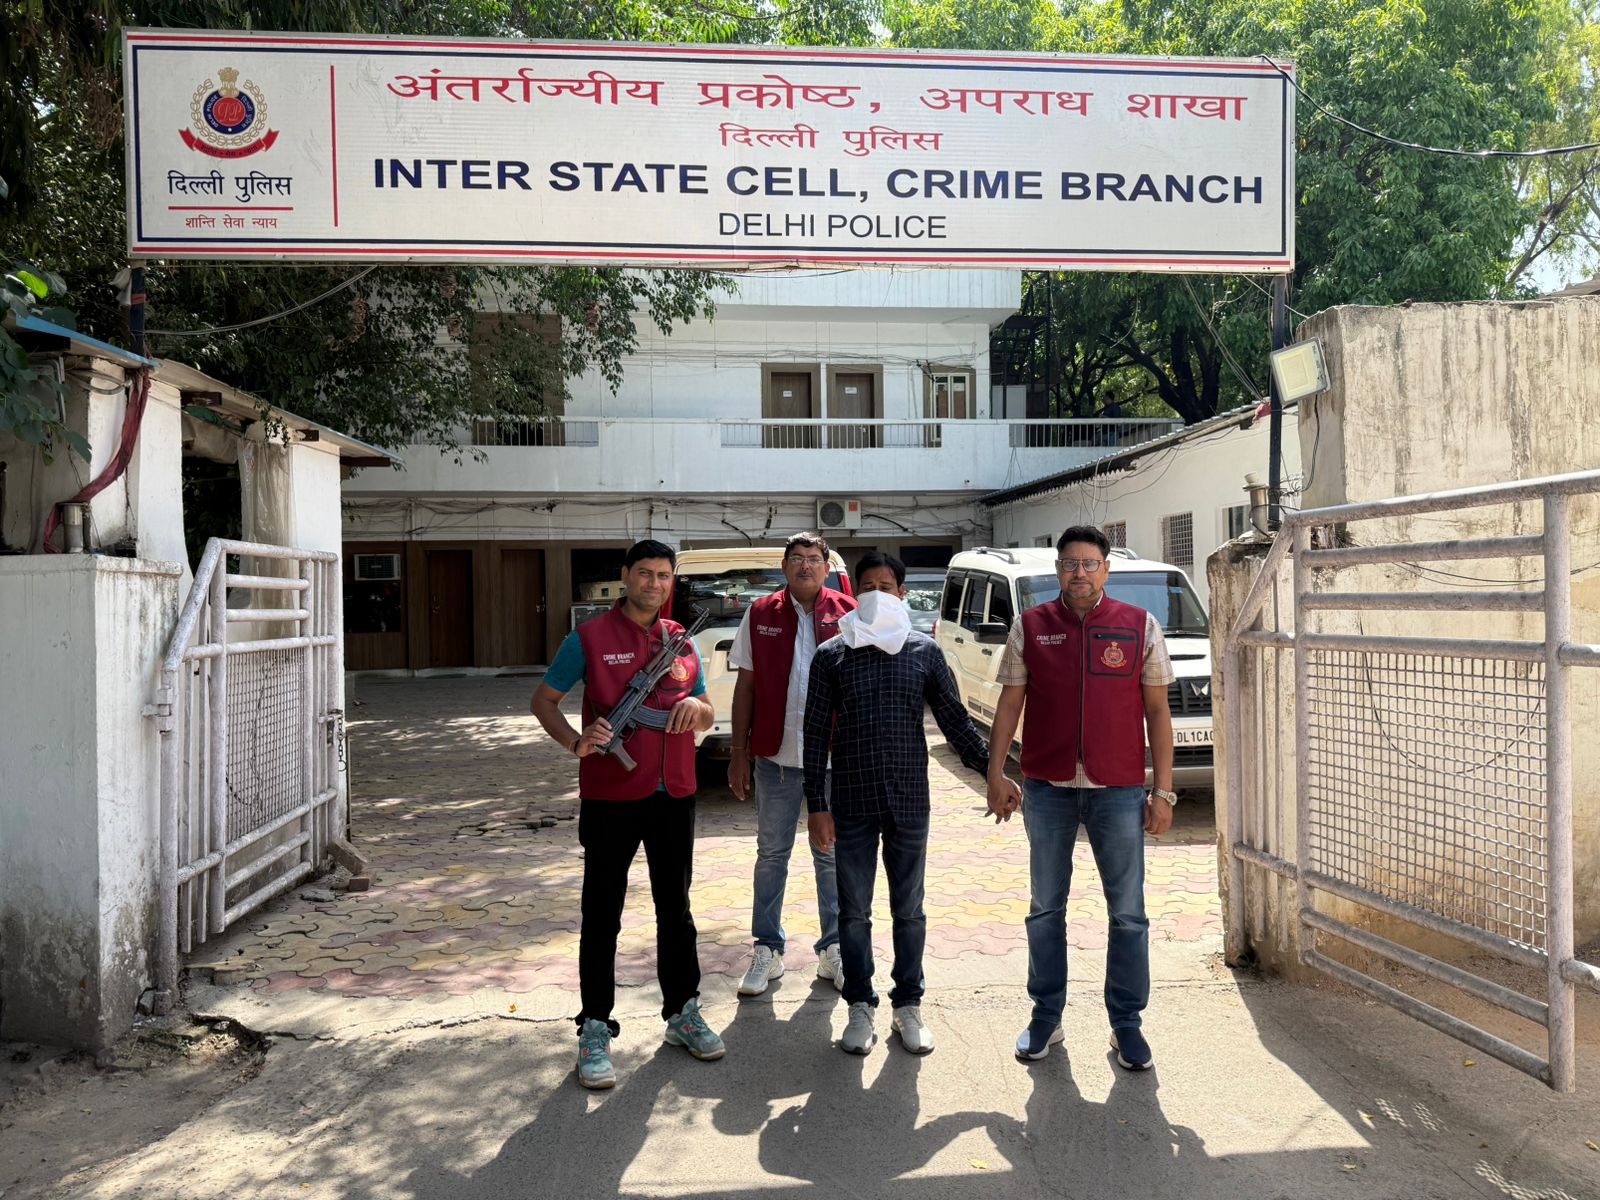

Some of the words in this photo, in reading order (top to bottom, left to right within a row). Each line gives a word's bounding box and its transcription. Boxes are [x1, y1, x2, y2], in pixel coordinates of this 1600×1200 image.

[386, 67, 665, 106] अंतर्राज्यीय
[919, 88, 1094, 117] अपराध
[1127, 94, 1249, 122] शाखा
[718, 122, 820, 149] दिल्ली
[842, 125, 944, 157] पुलिस
[167, 169, 225, 195] दिल्ली
[234, 170, 293, 203] पुलिस
[374, 158, 532, 191] INTER
[549, 161, 709, 195] STATE
[726, 165, 869, 204] CELL,
[886, 168, 1043, 200] CRIME
[1061, 171, 1263, 204] BRANCH
[185, 213, 217, 229] शान्ति
[223, 213, 245, 229] सेवा
[251, 216, 278, 229] न्याय
[718, 212, 815, 237] DELHI
[828, 214, 947, 239] POLICE
